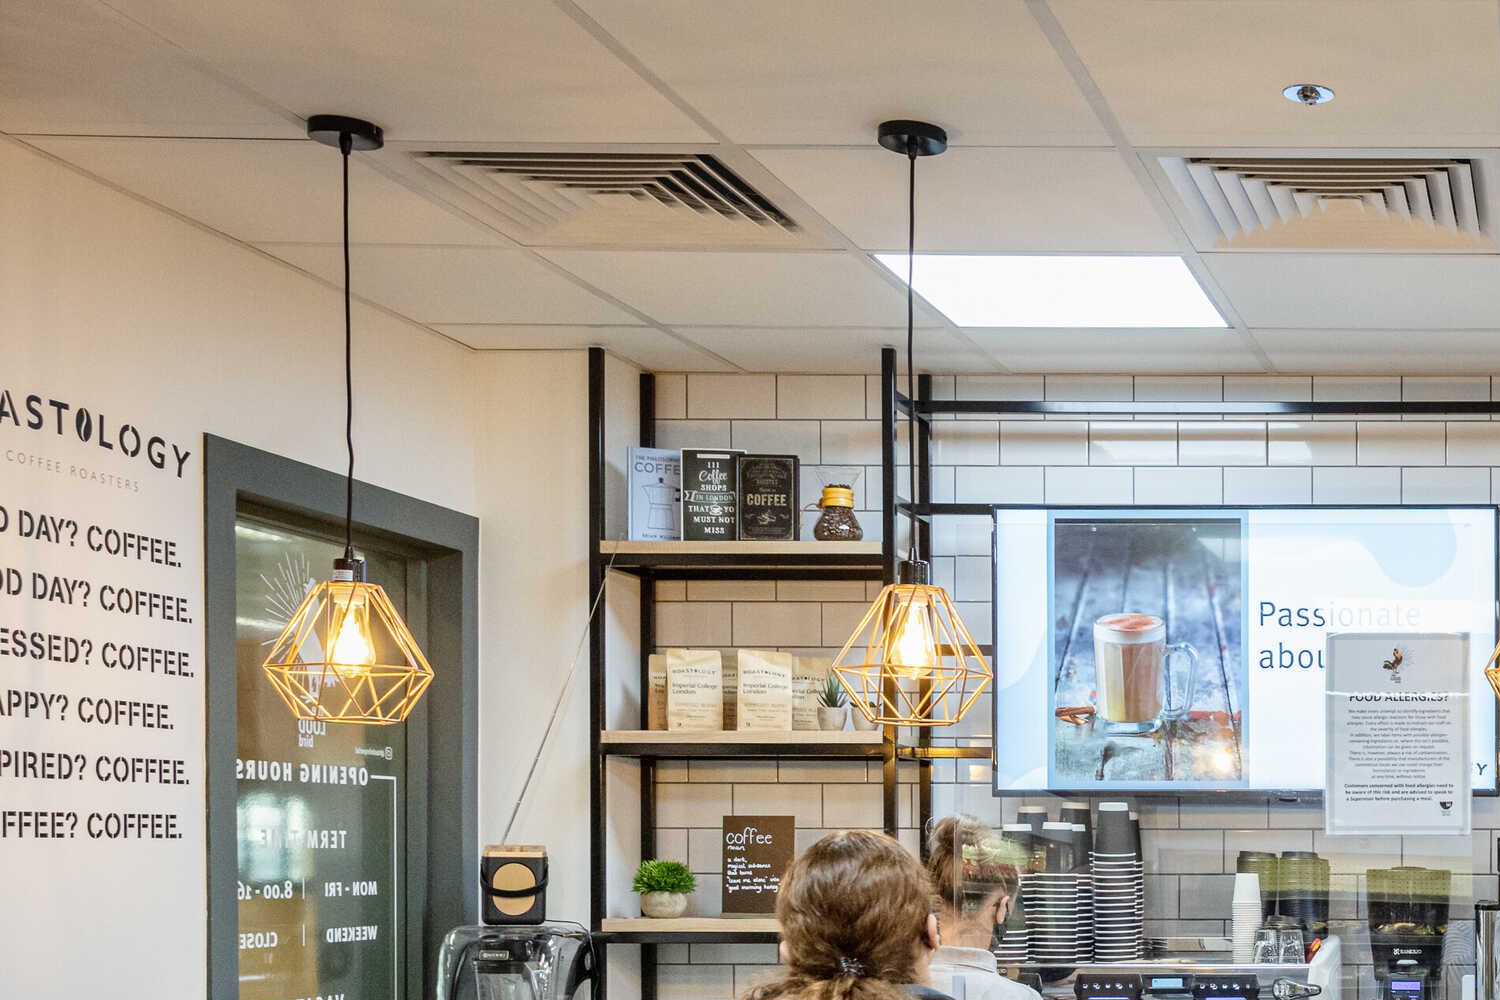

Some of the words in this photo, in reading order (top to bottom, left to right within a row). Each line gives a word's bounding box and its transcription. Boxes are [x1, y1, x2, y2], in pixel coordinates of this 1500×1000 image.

[6, 450, 60, 473] COFFEE
[70, 465, 139, 492] ROASTERS
[747, 494, 787, 506] COFFEE
[18, 509, 79, 548] DAY?
[86, 524, 183, 568] COFFEE.
[704, 527, 725, 535] MISS
[32, 572, 91, 607] DAY?
[99, 584, 193, 624] COFFEE.
[1260, 601, 1422, 627] Passionate
[101, 641, 195, 678] COFFEE.
[0, 689, 69, 721] PPY?
[78, 696, 174, 730] COFFEE.
[95, 755, 190, 785] COFFEE.
[2, 811, 78, 838] FFEE?
[87, 812, 182, 839] COFFEE.
[726, 827, 773, 844] coffee
